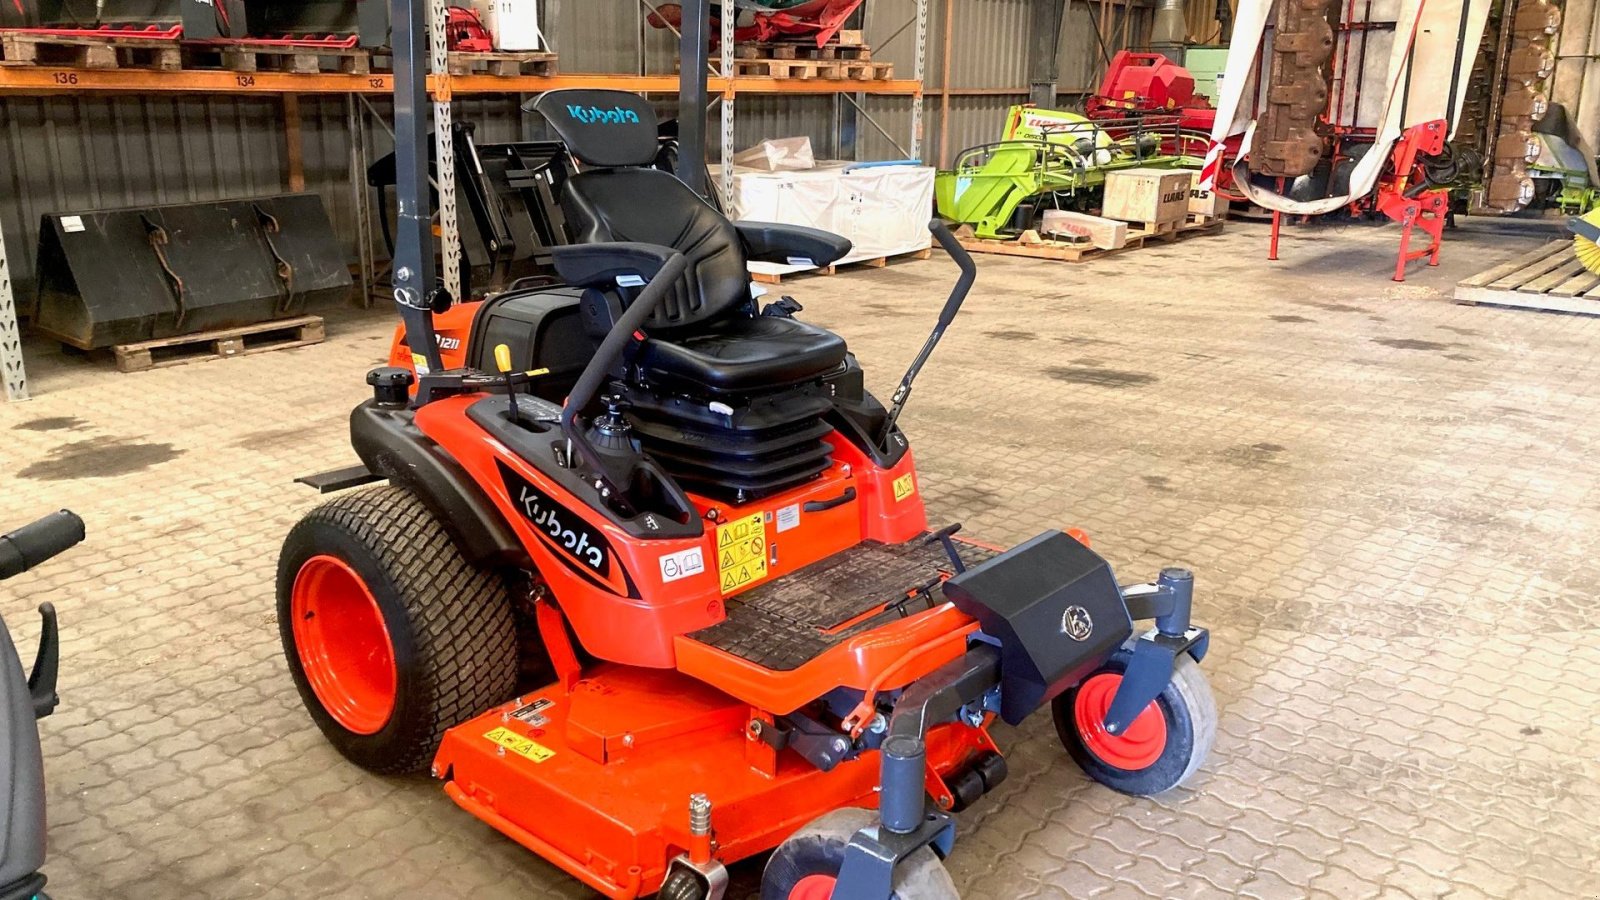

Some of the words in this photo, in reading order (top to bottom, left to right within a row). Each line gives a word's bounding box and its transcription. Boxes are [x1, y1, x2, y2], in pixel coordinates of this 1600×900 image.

[52, 72, 78, 84] 136
[236, 75, 255, 87] 134
[369, 78, 384, 88] 132
[566, 104, 639, 124] Kubota
[1163, 190, 1185, 203] CLAAS
[519, 485, 603, 568] Kubota
